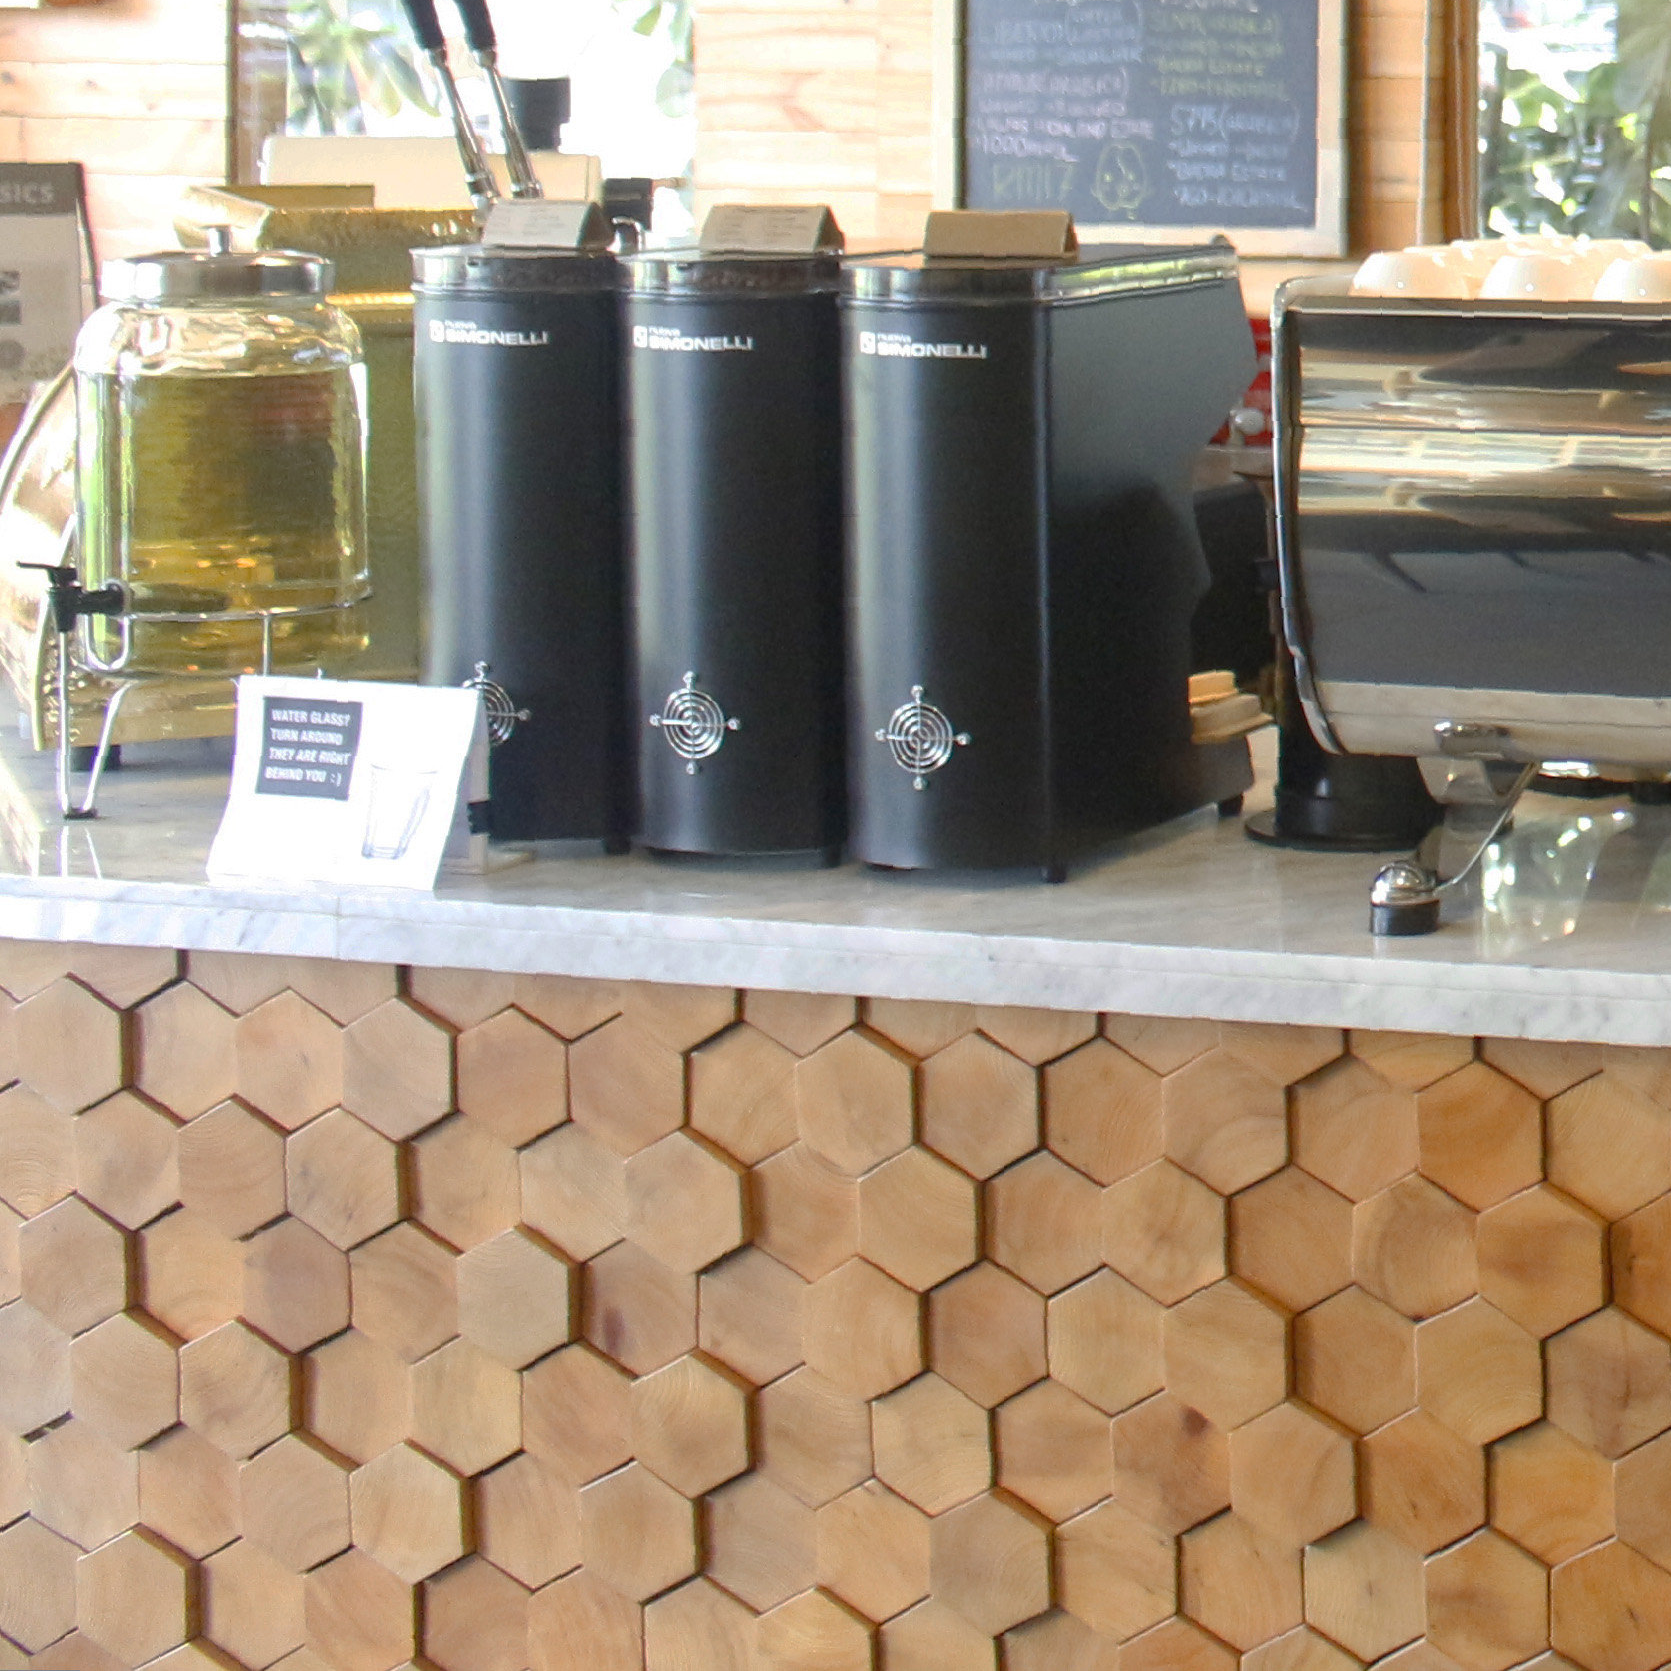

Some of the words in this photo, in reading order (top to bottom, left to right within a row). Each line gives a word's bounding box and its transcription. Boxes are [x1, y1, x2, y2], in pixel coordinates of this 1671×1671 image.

[445, 329, 549, 346] SIMONELLI
[649, 335, 754, 352] SIMONELLI
[877, 341, 988, 360] SIMONELLI
[271, 708, 308, 724] WATER
[270, 727, 299, 742] TURN
[299, 729, 344, 746] AROUND
[269, 746, 296, 761] THEY
[295, 748, 318, 763] ARE
[318, 750, 352, 766] RIGHT
[264, 766, 304, 781] BEHIND
[305, 769, 327, 783] YOU
